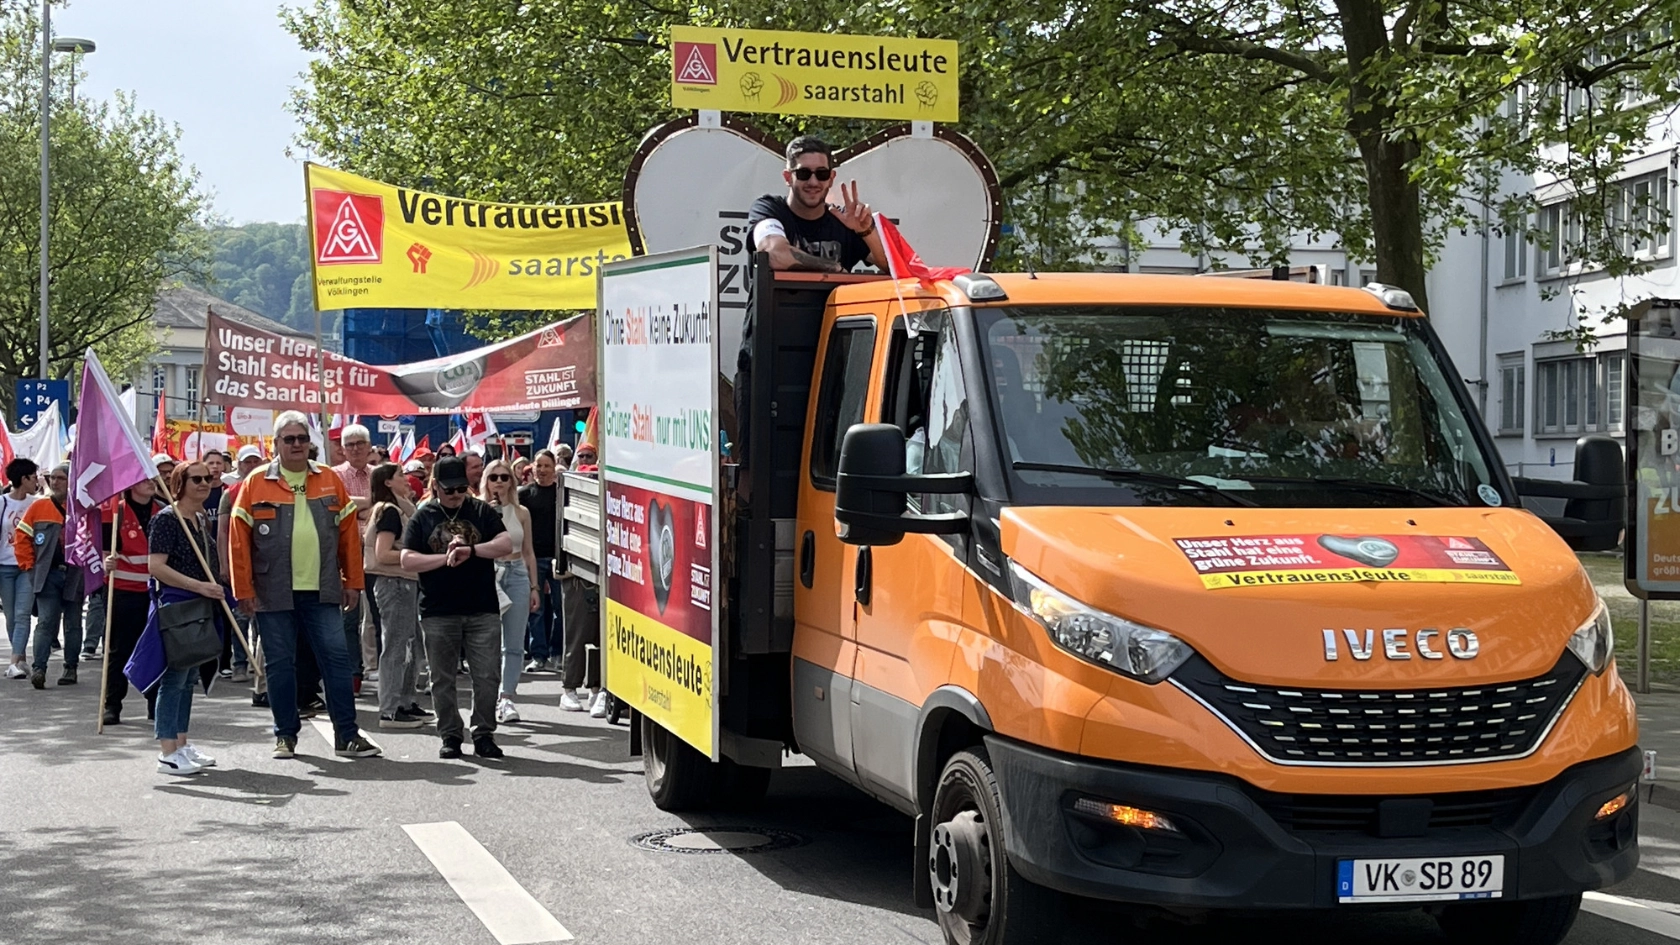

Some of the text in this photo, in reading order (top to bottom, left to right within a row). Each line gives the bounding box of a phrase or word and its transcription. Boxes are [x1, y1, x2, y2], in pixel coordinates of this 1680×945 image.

[722, 36, 947, 74] Vertrauensleute
[803, 82, 904, 104] saarstahl
[327, 287, 369, 296] Völklingen
[605, 301, 712, 351] Ohne Stahl, keine Zukunft!
[218, 327, 274, 354] Unser
[217, 350, 378, 388] Stahl schlägt für
[524, 368, 576, 385] STAHL IST
[36, 382, 47, 390] P2
[215, 375, 343, 405] das Saarland
[526, 379, 577, 396] ZUKUNFT
[36, 394, 50, 405] P4
[541, 397, 581, 408] Dillinger
[606, 401, 631, 439] Grüner
[632, 402, 654, 449] Stahl,
[656, 414, 671, 445] nur
[672, 408, 687, 448] mit
[606, 490, 645, 525] Unser Herz aus
[606, 518, 642, 554] Stahl hat eine
[1176, 537, 1305, 549] Unser Herz aus
[1185, 545, 1304, 559] Stahl hat eine
[1194, 555, 1322, 571] grüne Zukunft.
[1226, 569, 1412, 585] Vertrauensleute
[1464, 571, 1519, 581] saarstahl
[1321, 626, 1480, 661] IVECO
[615, 614, 703, 696] Vertrauensleute
[648, 685, 671, 712] saarstahl
[1342, 881, 1349, 891] D
[1365, 859, 1493, 891] VK SB 89
